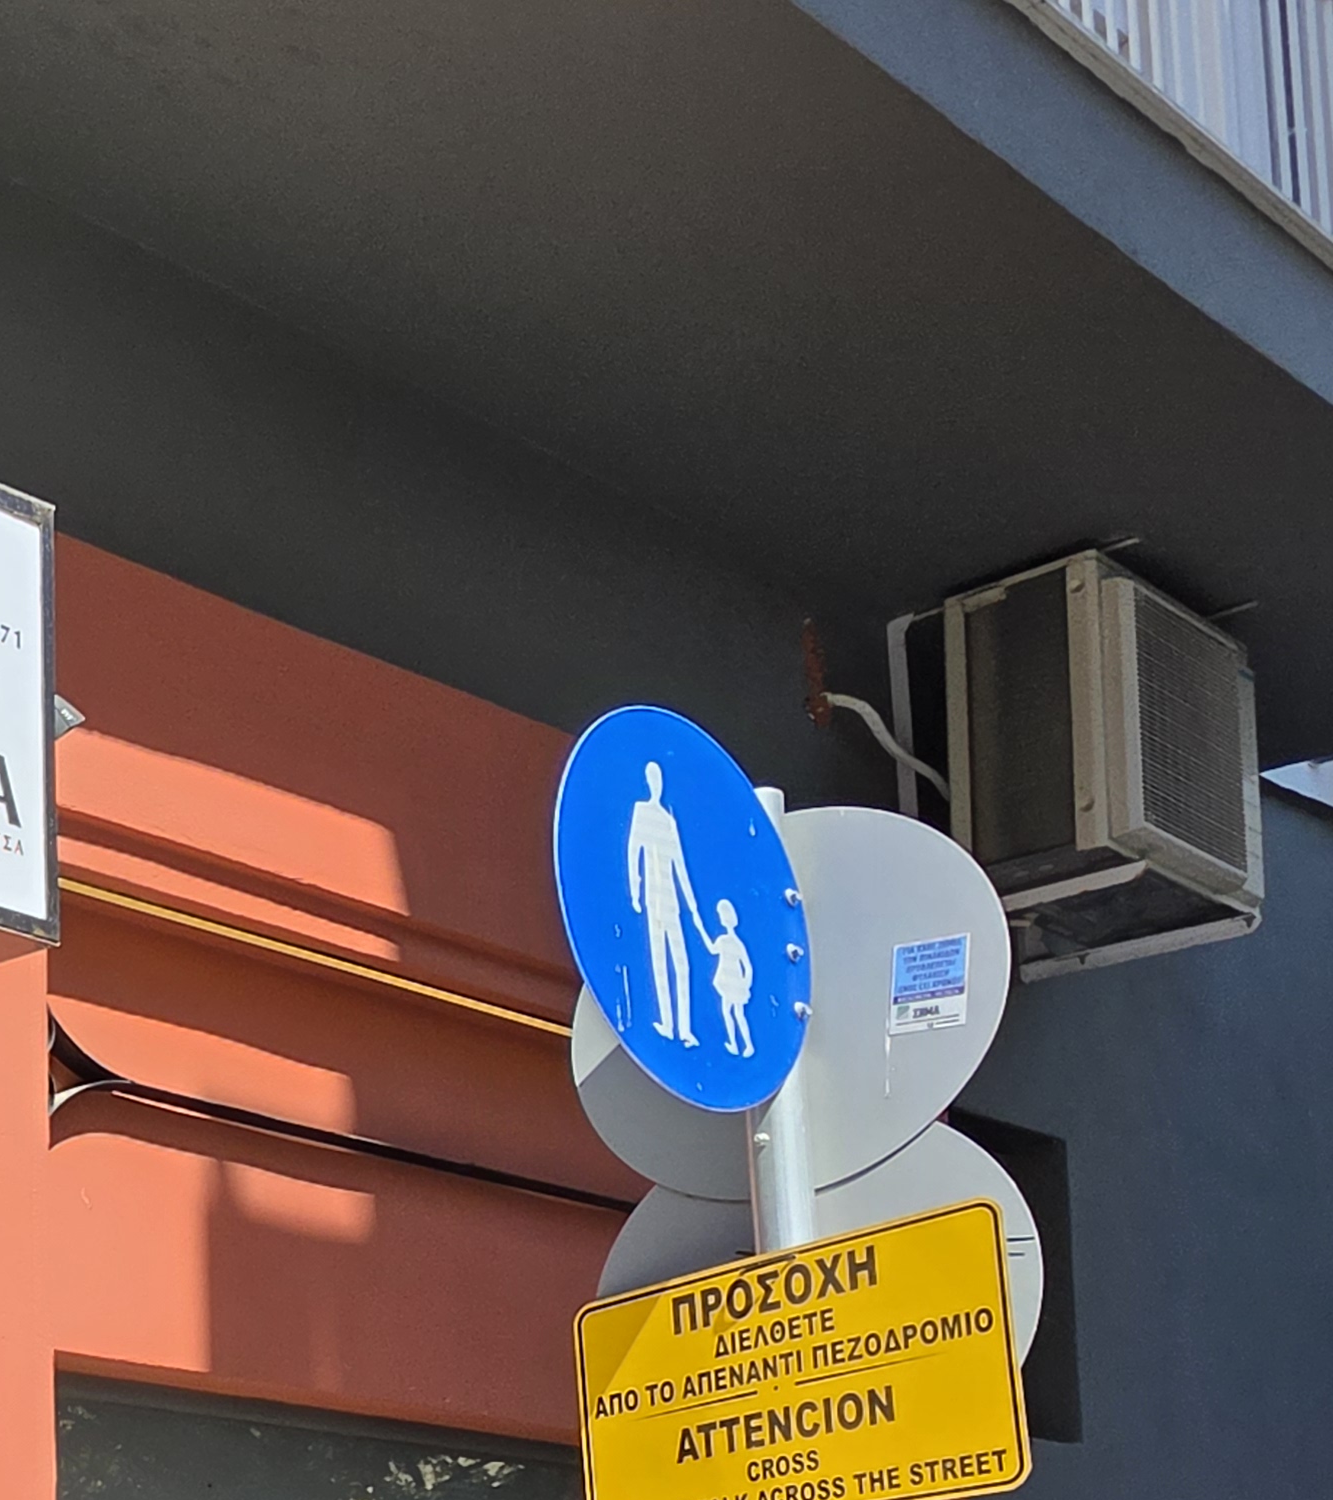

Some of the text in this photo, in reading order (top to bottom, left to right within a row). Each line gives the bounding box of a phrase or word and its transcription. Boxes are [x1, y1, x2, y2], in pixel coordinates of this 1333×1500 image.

[671, 1244, 878, 1336] ΠΡΟΣΟΧΗ
[594, 1307, 994, 1420] ΑΠΟ ΤΟ ΑΠΕΝΑΝΤΙ ΠΕΖΟΔΡΟΜΙΟ
[714, 1307, 836, 1359] ΔΙΕΛΘΕΤΕ
[676, 1384, 896, 1465] ATTENCION
[746, 1449, 820, 1483] CROSS
[852, 1466, 902, 1495] THE
[909, 1448, 1008, 1486] STREET
